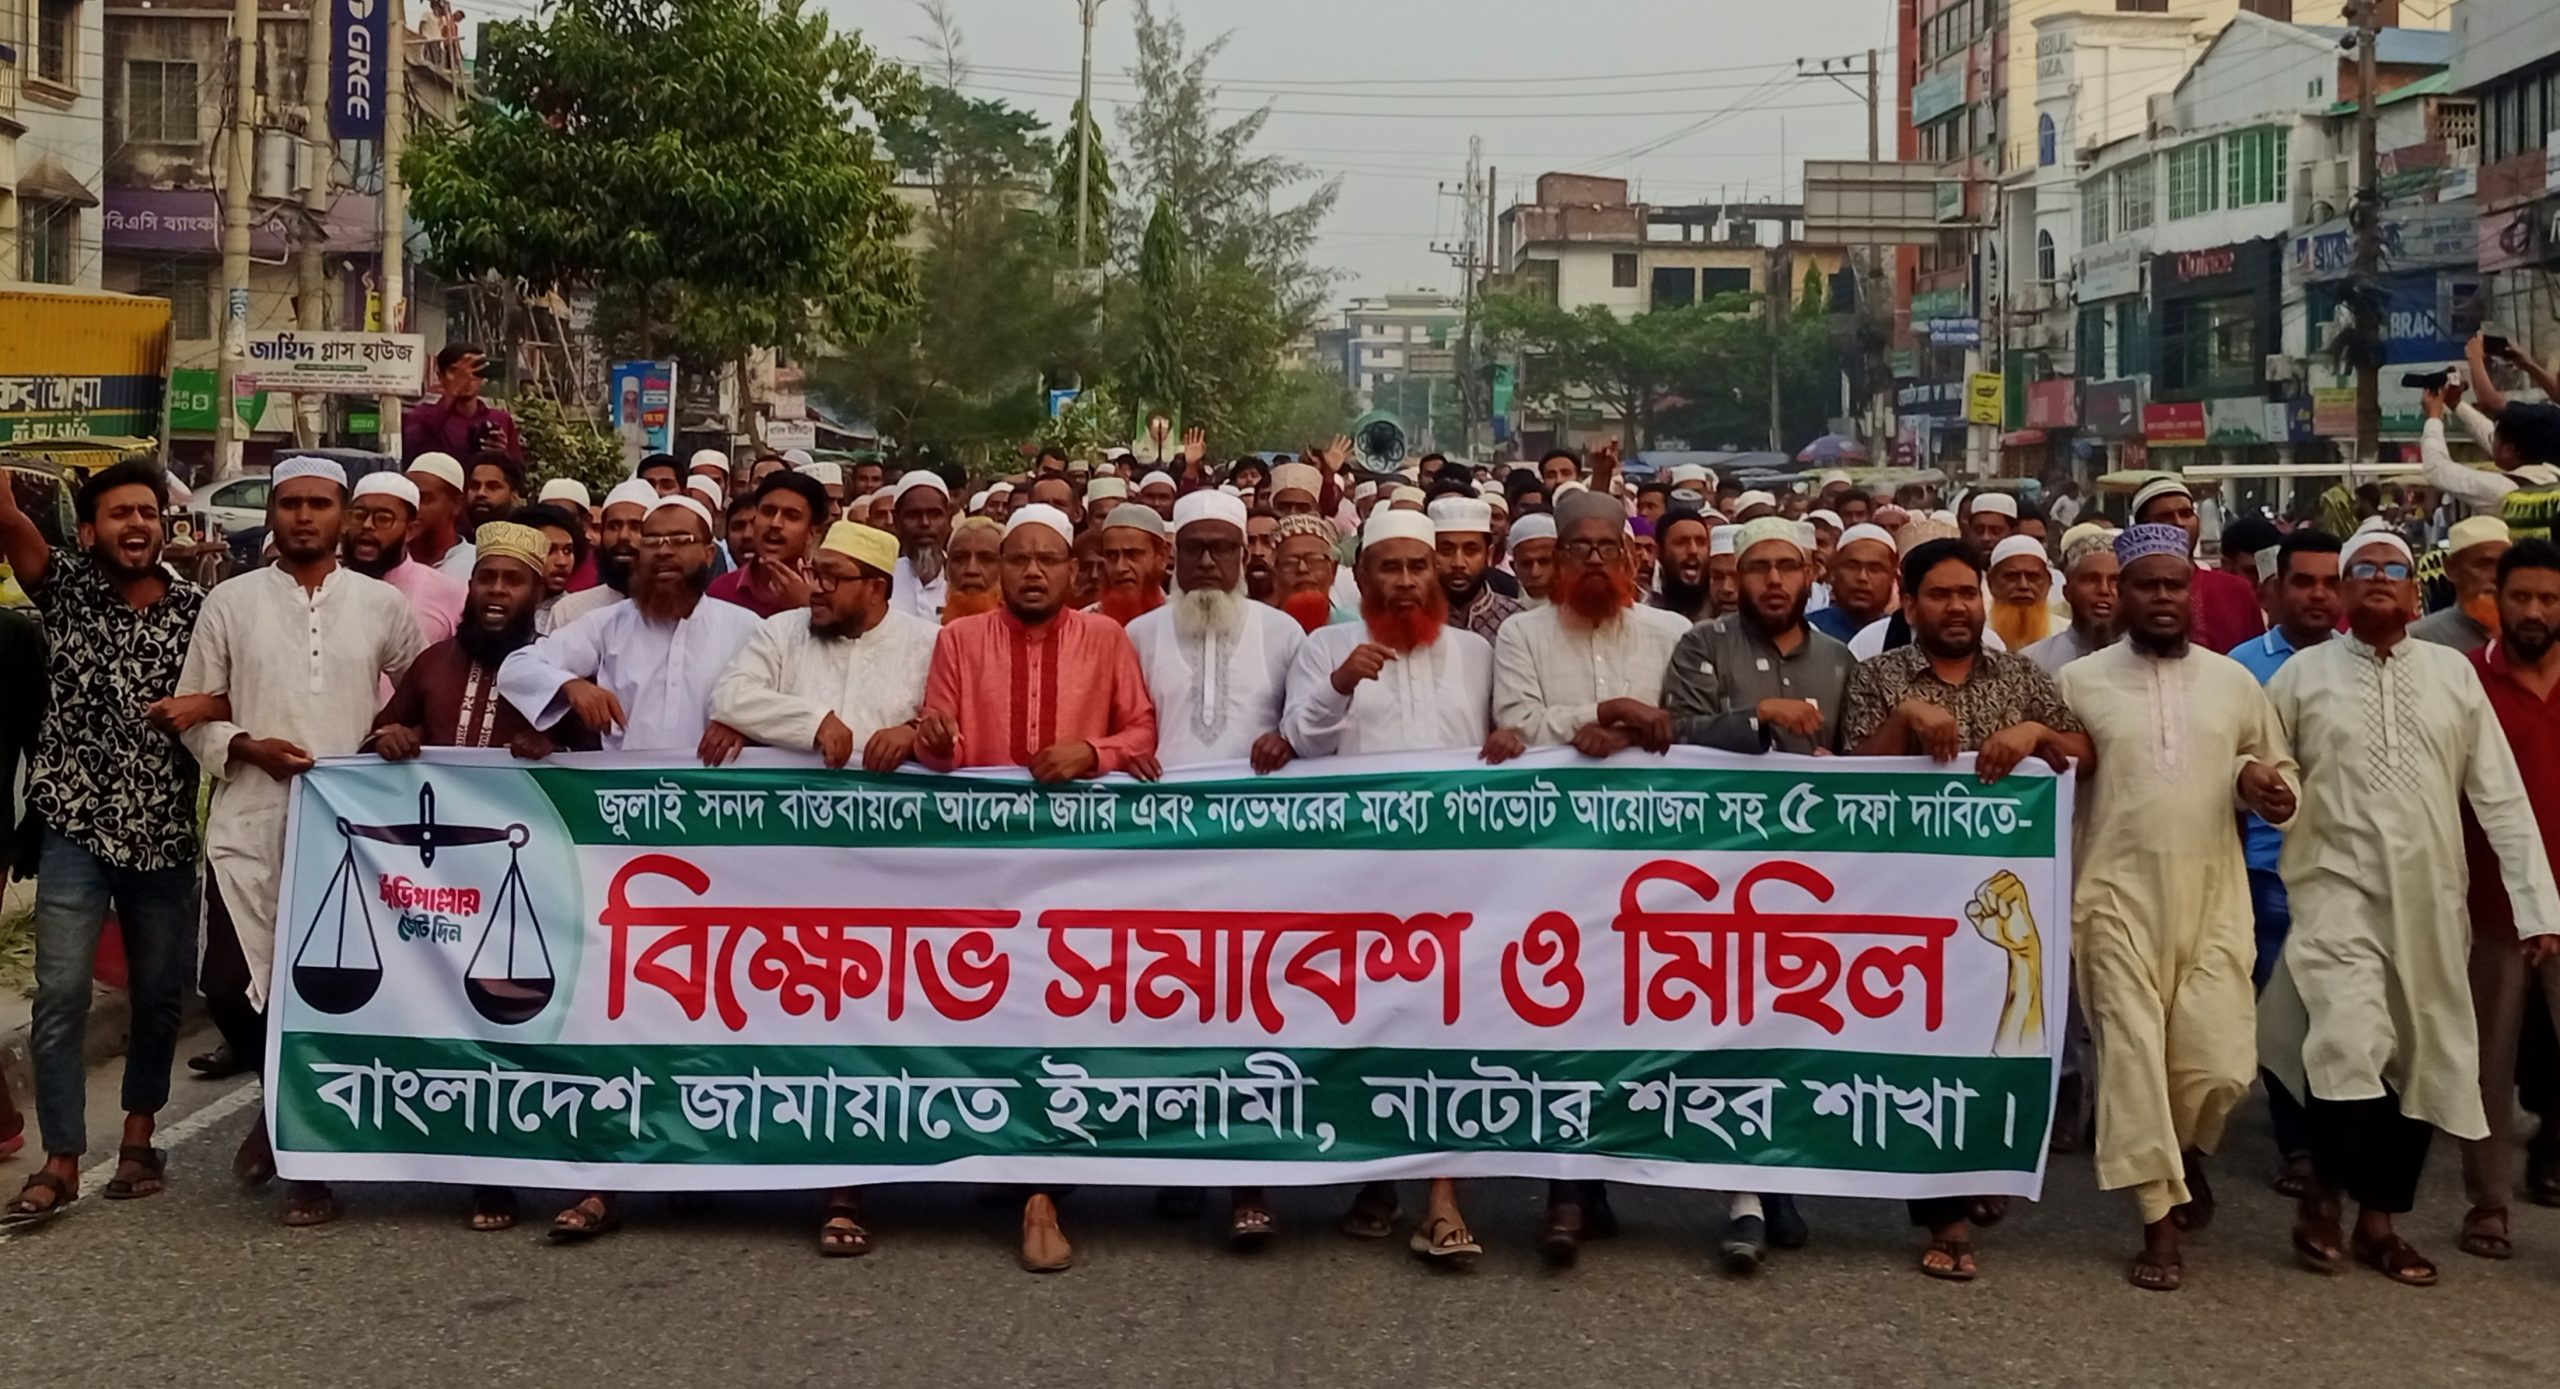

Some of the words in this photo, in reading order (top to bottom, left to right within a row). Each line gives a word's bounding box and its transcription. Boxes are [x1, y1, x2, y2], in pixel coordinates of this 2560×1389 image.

[347, 24, 371, 121] GREE
[102, 210, 158, 232] বিএসি
[163, 214, 215, 232] ব্যাংক
[2390, 309, 2435, 338] BRAC
[249, 332, 315, 361] জাহিদ
[321, 340, 356, 363] গ্লাস
[361, 338, 415, 363] হাউজ
[594, 777, 687, 839] জুলাই
[695, 790, 768, 829] সনদ
[776, 785, 927, 831] বাস্তবায়নে
[933, 790, 1039, 831] আদেশ
[1047, 783, 1120, 832] জারি
[1131, 794, 1197, 836] এবং
[1205, 792, 1350, 833] নভেম্বরের
[1357, 790, 1434, 834] মধ্যে
[1443, 777, 1561, 833] গণভোট
[1568, 785, 1710, 833] আয়োজন
[1716, 792, 1768, 839] সহ
[1779, 782, 1823, 833] ৫
[1834, 790, 1901, 836] দফা
[432, 914, 462, 944] দিন
[598, 853, 1021, 1030] বিক্ষোভ
[1038, 909, 1474, 1034] সমাবেশ
[1500, 910, 1585, 1028] ও
[1611, 859, 1959, 1035] মিছিল
[308, 1057, 655, 1139] বাংলাদেশ
[671, 1066, 1022, 1141] জামায়াতে
[1035, 1051, 1336, 1153] ইসলামী,
[1361, 1056, 1605, 1143] নাটোর
[1618, 1071, 1787, 1150] শহর
[1801, 1073, 1980, 1150] শাখা
